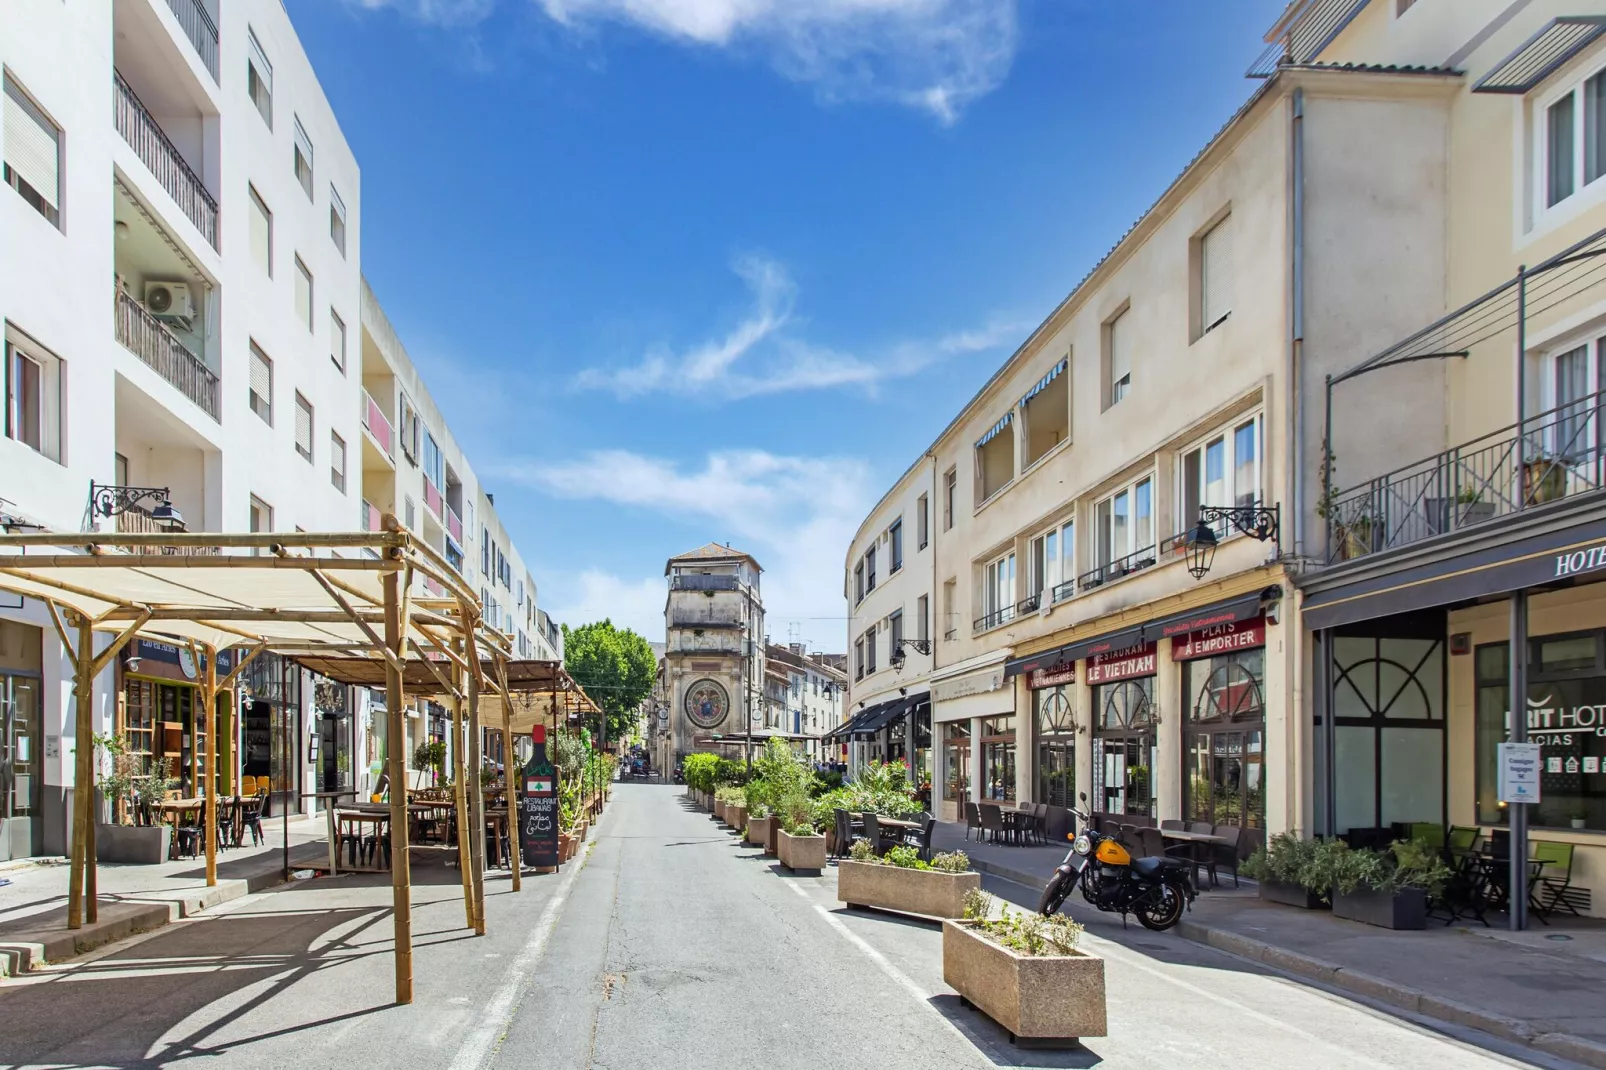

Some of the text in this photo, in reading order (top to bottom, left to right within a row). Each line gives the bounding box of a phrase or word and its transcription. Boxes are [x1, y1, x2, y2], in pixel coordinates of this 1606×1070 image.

[1202, 622, 1235, 638] PLATS
[1195, 630, 1255, 653] EMPORTER
[1094, 642, 1147, 663] RESTAURANT
[1088, 655, 1154, 681] LE VIETNAM
[523, 797, 557, 805] RESTAURANT
[526, 804, 552, 812] LIBANAIS
